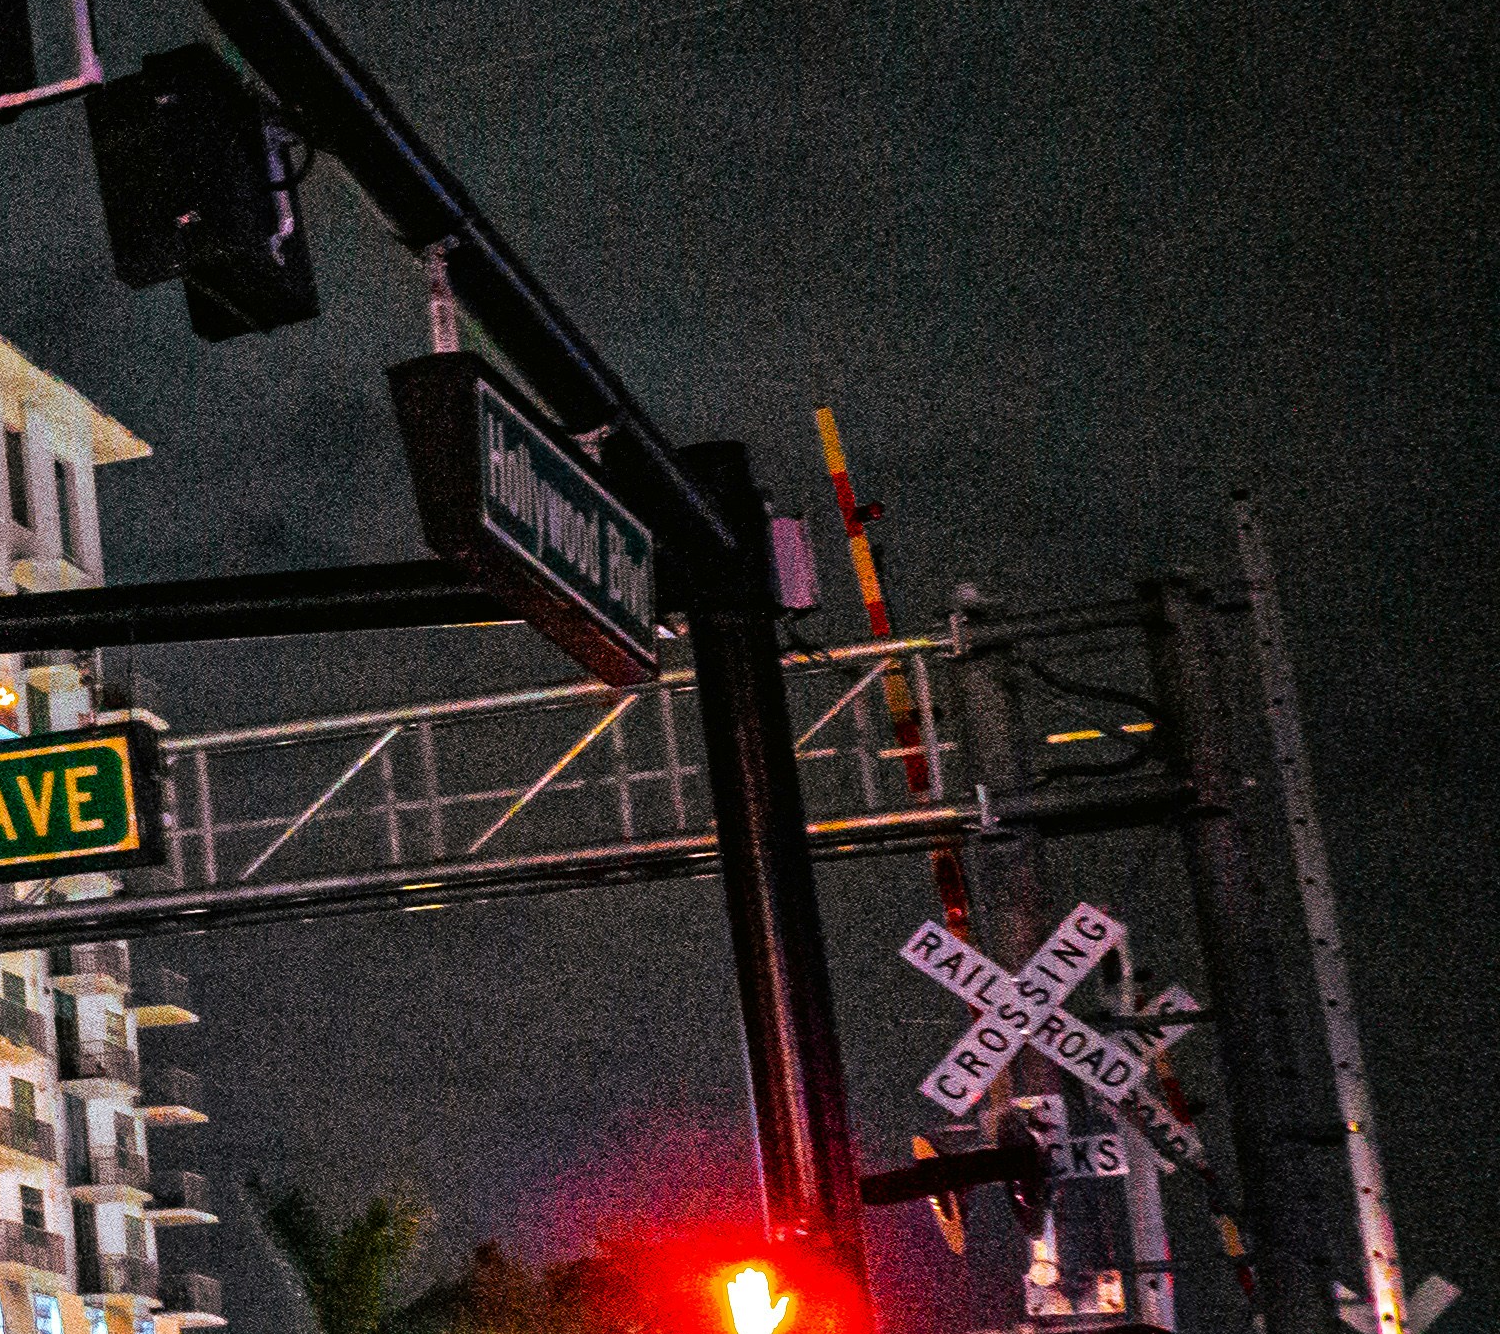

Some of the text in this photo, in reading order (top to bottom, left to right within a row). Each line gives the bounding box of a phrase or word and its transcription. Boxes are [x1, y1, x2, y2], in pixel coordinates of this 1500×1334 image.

[488, 413, 600, 587] Hollywood
[911, 931, 1002, 1005] RAIL
[1034, 1015, 1133, 1087] ROAD
[937, 914, 1107, 1100] CROSSING
